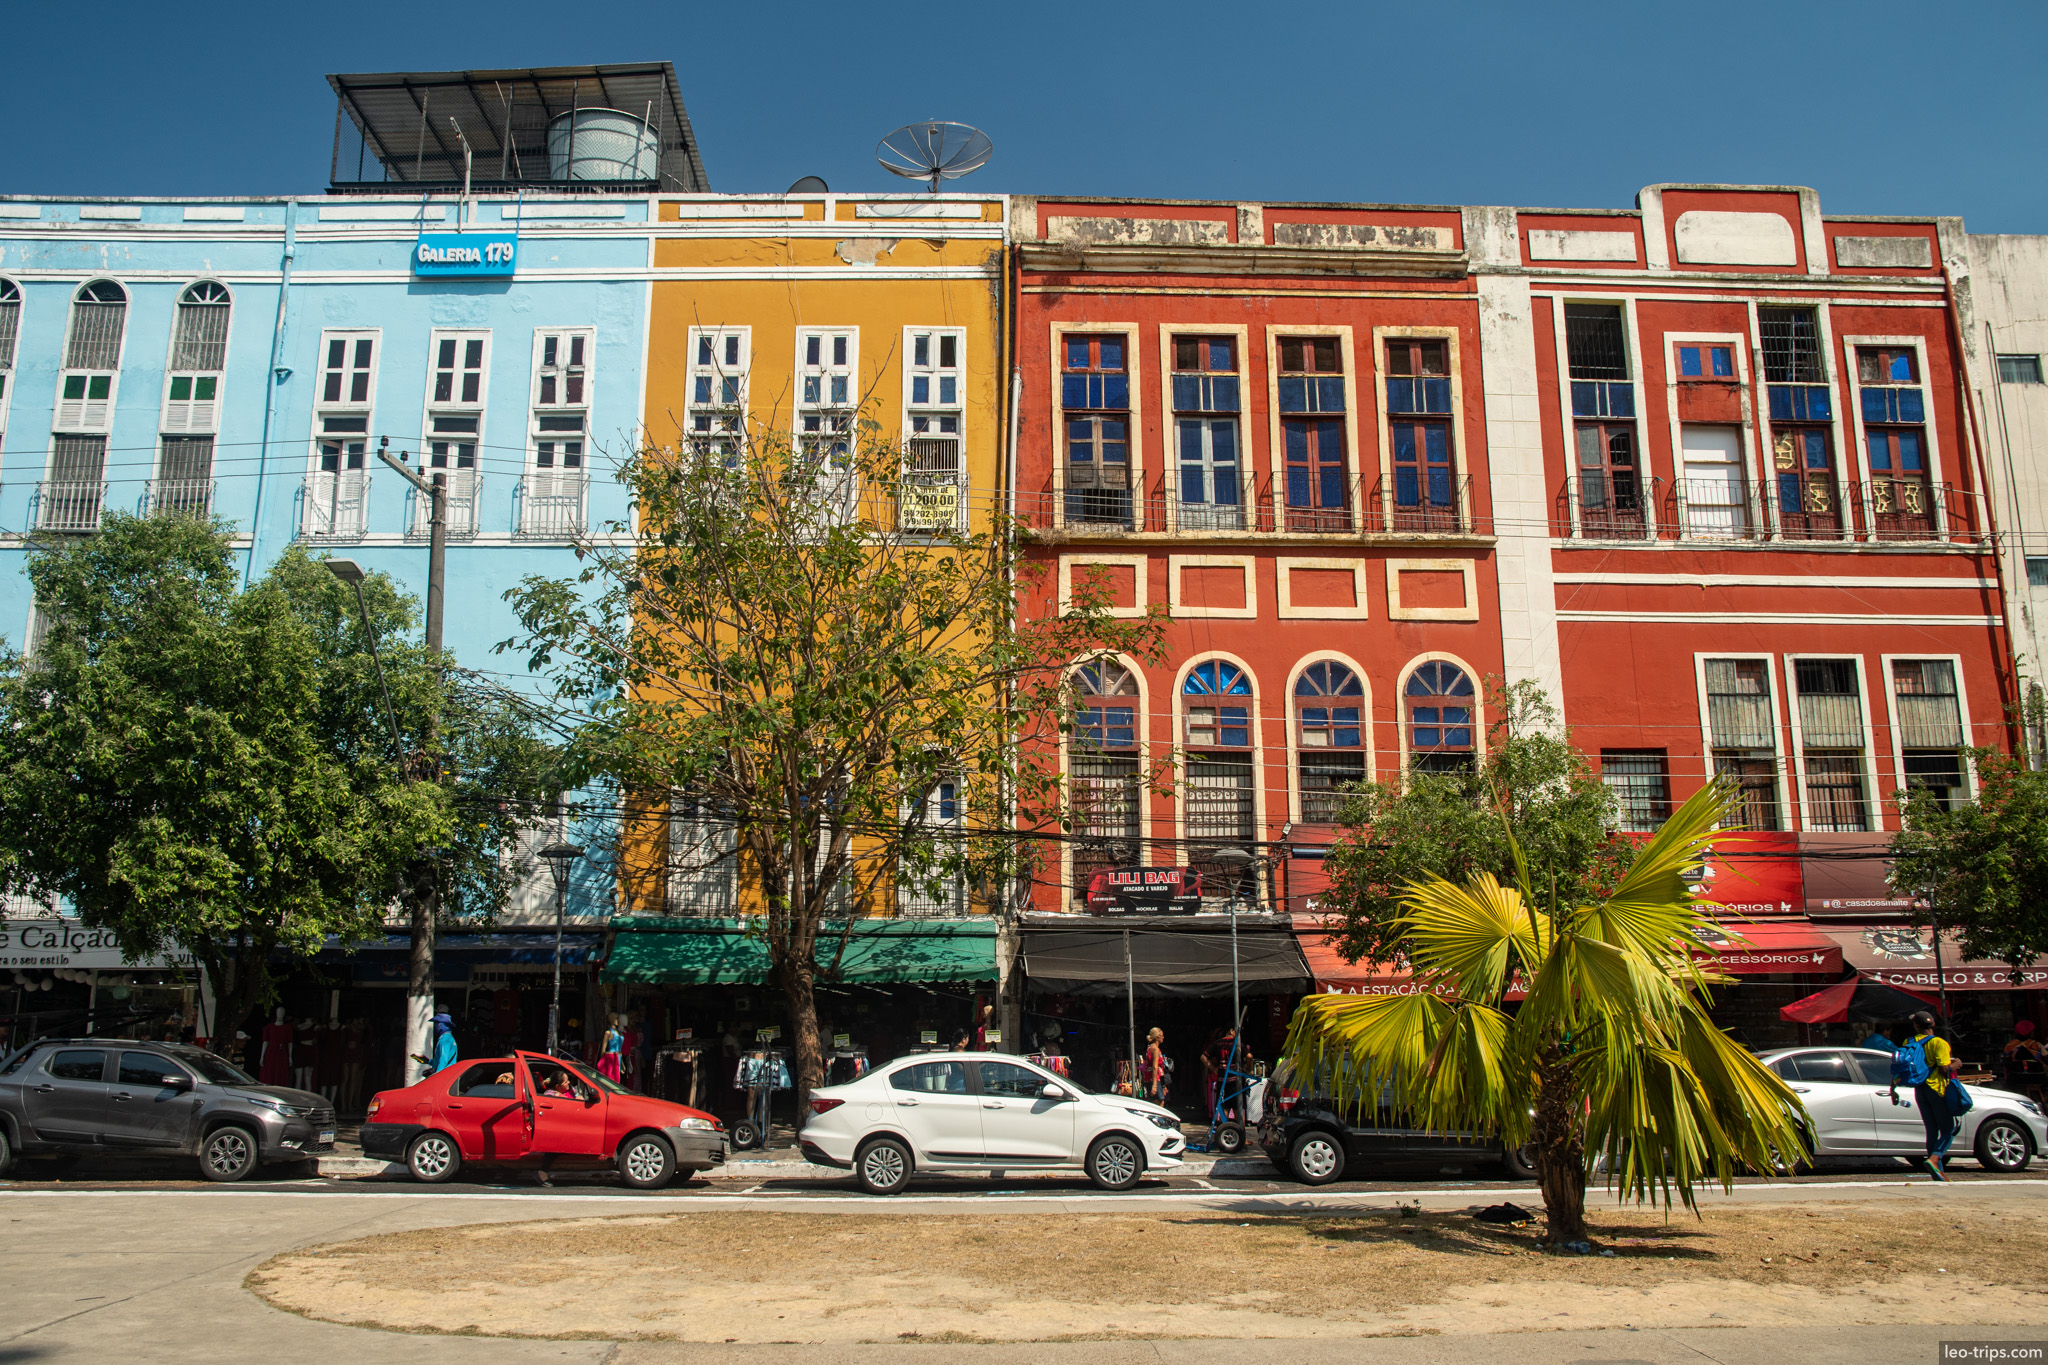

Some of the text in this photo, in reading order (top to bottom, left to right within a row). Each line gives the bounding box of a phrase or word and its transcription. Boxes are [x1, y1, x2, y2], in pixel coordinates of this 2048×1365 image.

[418, 242, 514, 263] GALERIA 179
[1108, 871, 1180, 885] LILI BAG
[12, 957, 18, 965] o
[20, 957, 37, 965] seu
[40, 954, 69, 965] estilo
[1711, 954, 1810, 965] ACESSÓRIOS
[1890, 974, 1967, 985] CABELO
[1974, 974, 1986, 984] &
[1273, 1000, 1281, 1017] 167
